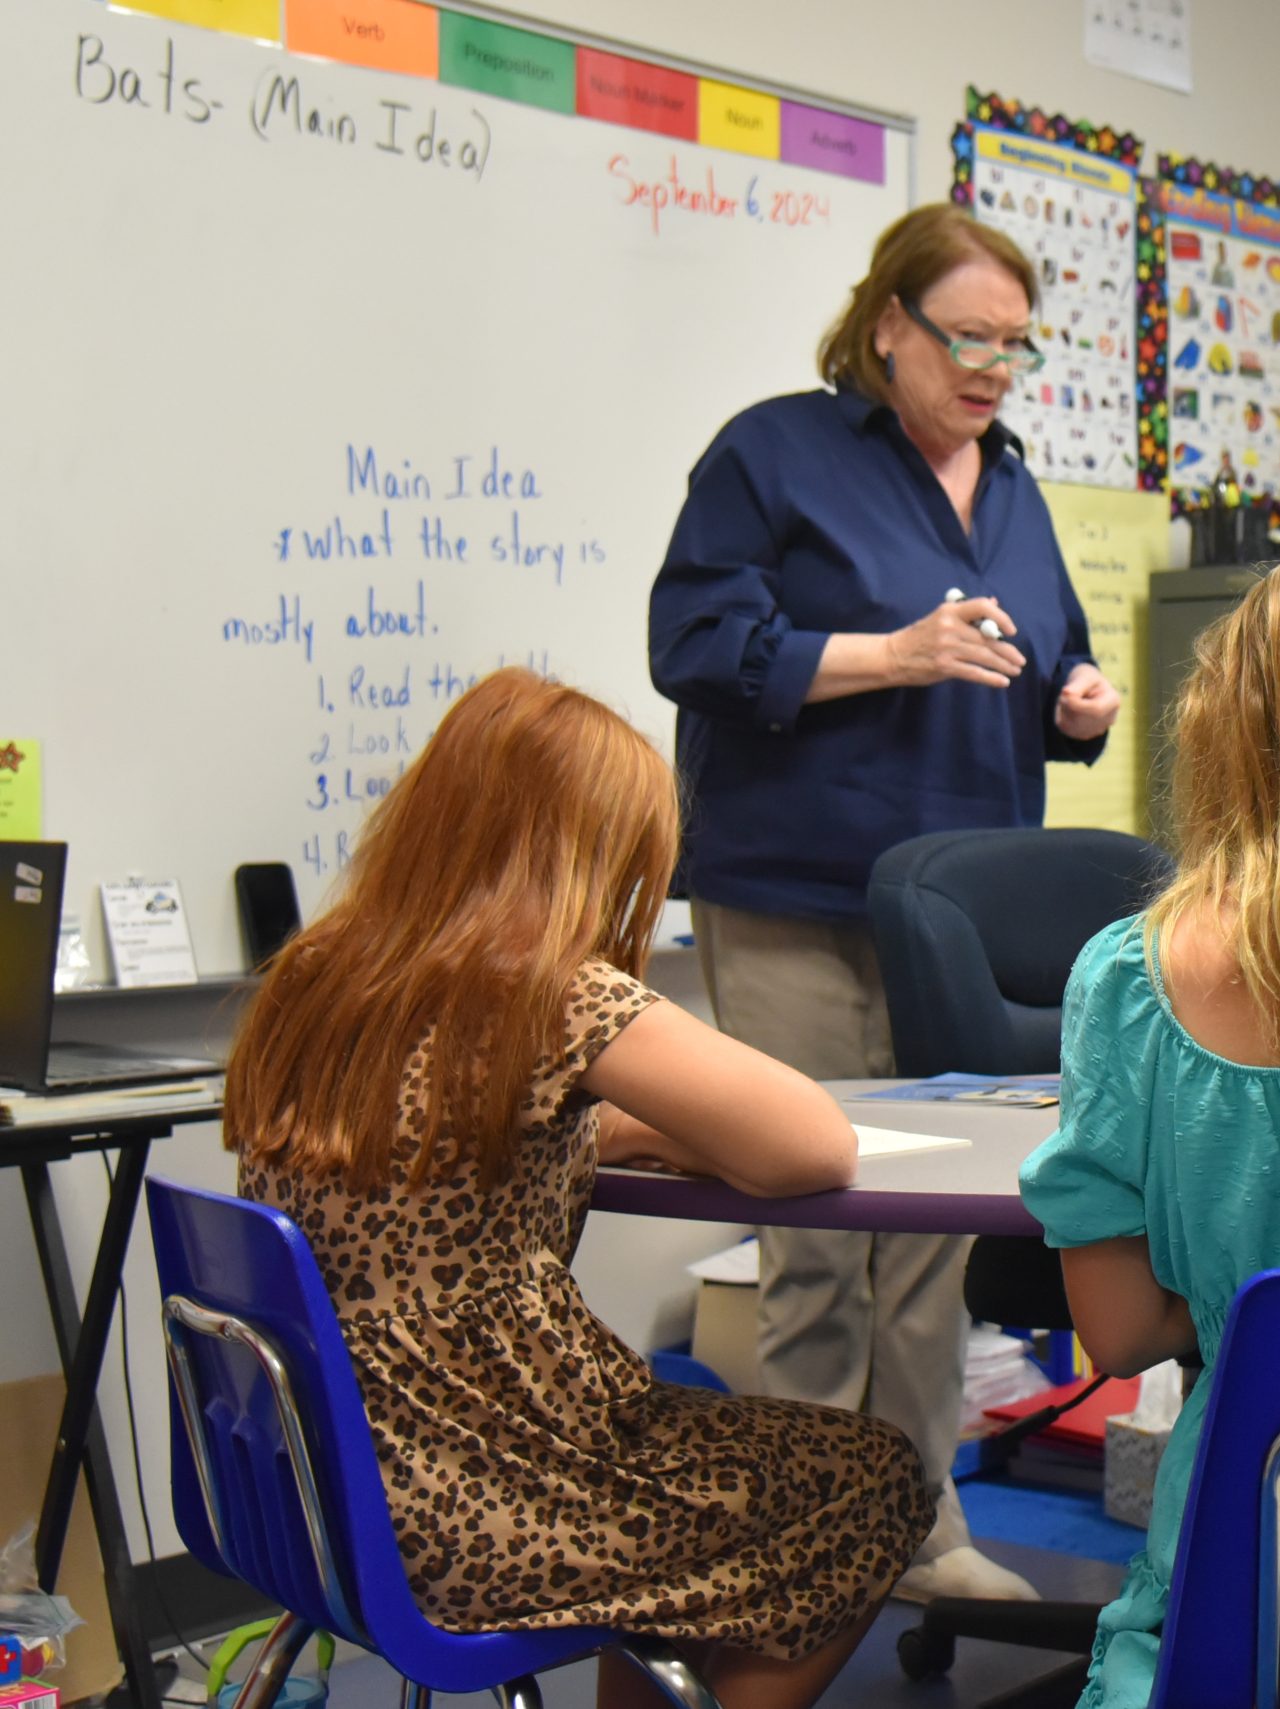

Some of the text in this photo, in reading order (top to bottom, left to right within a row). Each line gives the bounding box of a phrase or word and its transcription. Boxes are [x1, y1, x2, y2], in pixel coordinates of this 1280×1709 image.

[342, 16, 386, 42] Verb
[464, 41, 555, 82] Preposition
[250, 66, 356, 142] (Main
[375, 100, 491, 182] Idea)
[725, 106, 764, 131] Noun
[607, 152, 737, 237] September
[769, 190, 831, 227] 2024
[346, 443, 542, 500] Main Idea
[418, 515, 468, 561] the
[491, 510, 564, 585] story
[579, 518, 606, 563] is
[222, 579, 438, 662] mostly about.
[318, 672, 335, 712] 1.
[349, 664, 411, 708] Read
[348, 716, 411, 756] Look
[305, 758, 405, 811] 3. Loo
[302, 833, 328, 876] 4.
